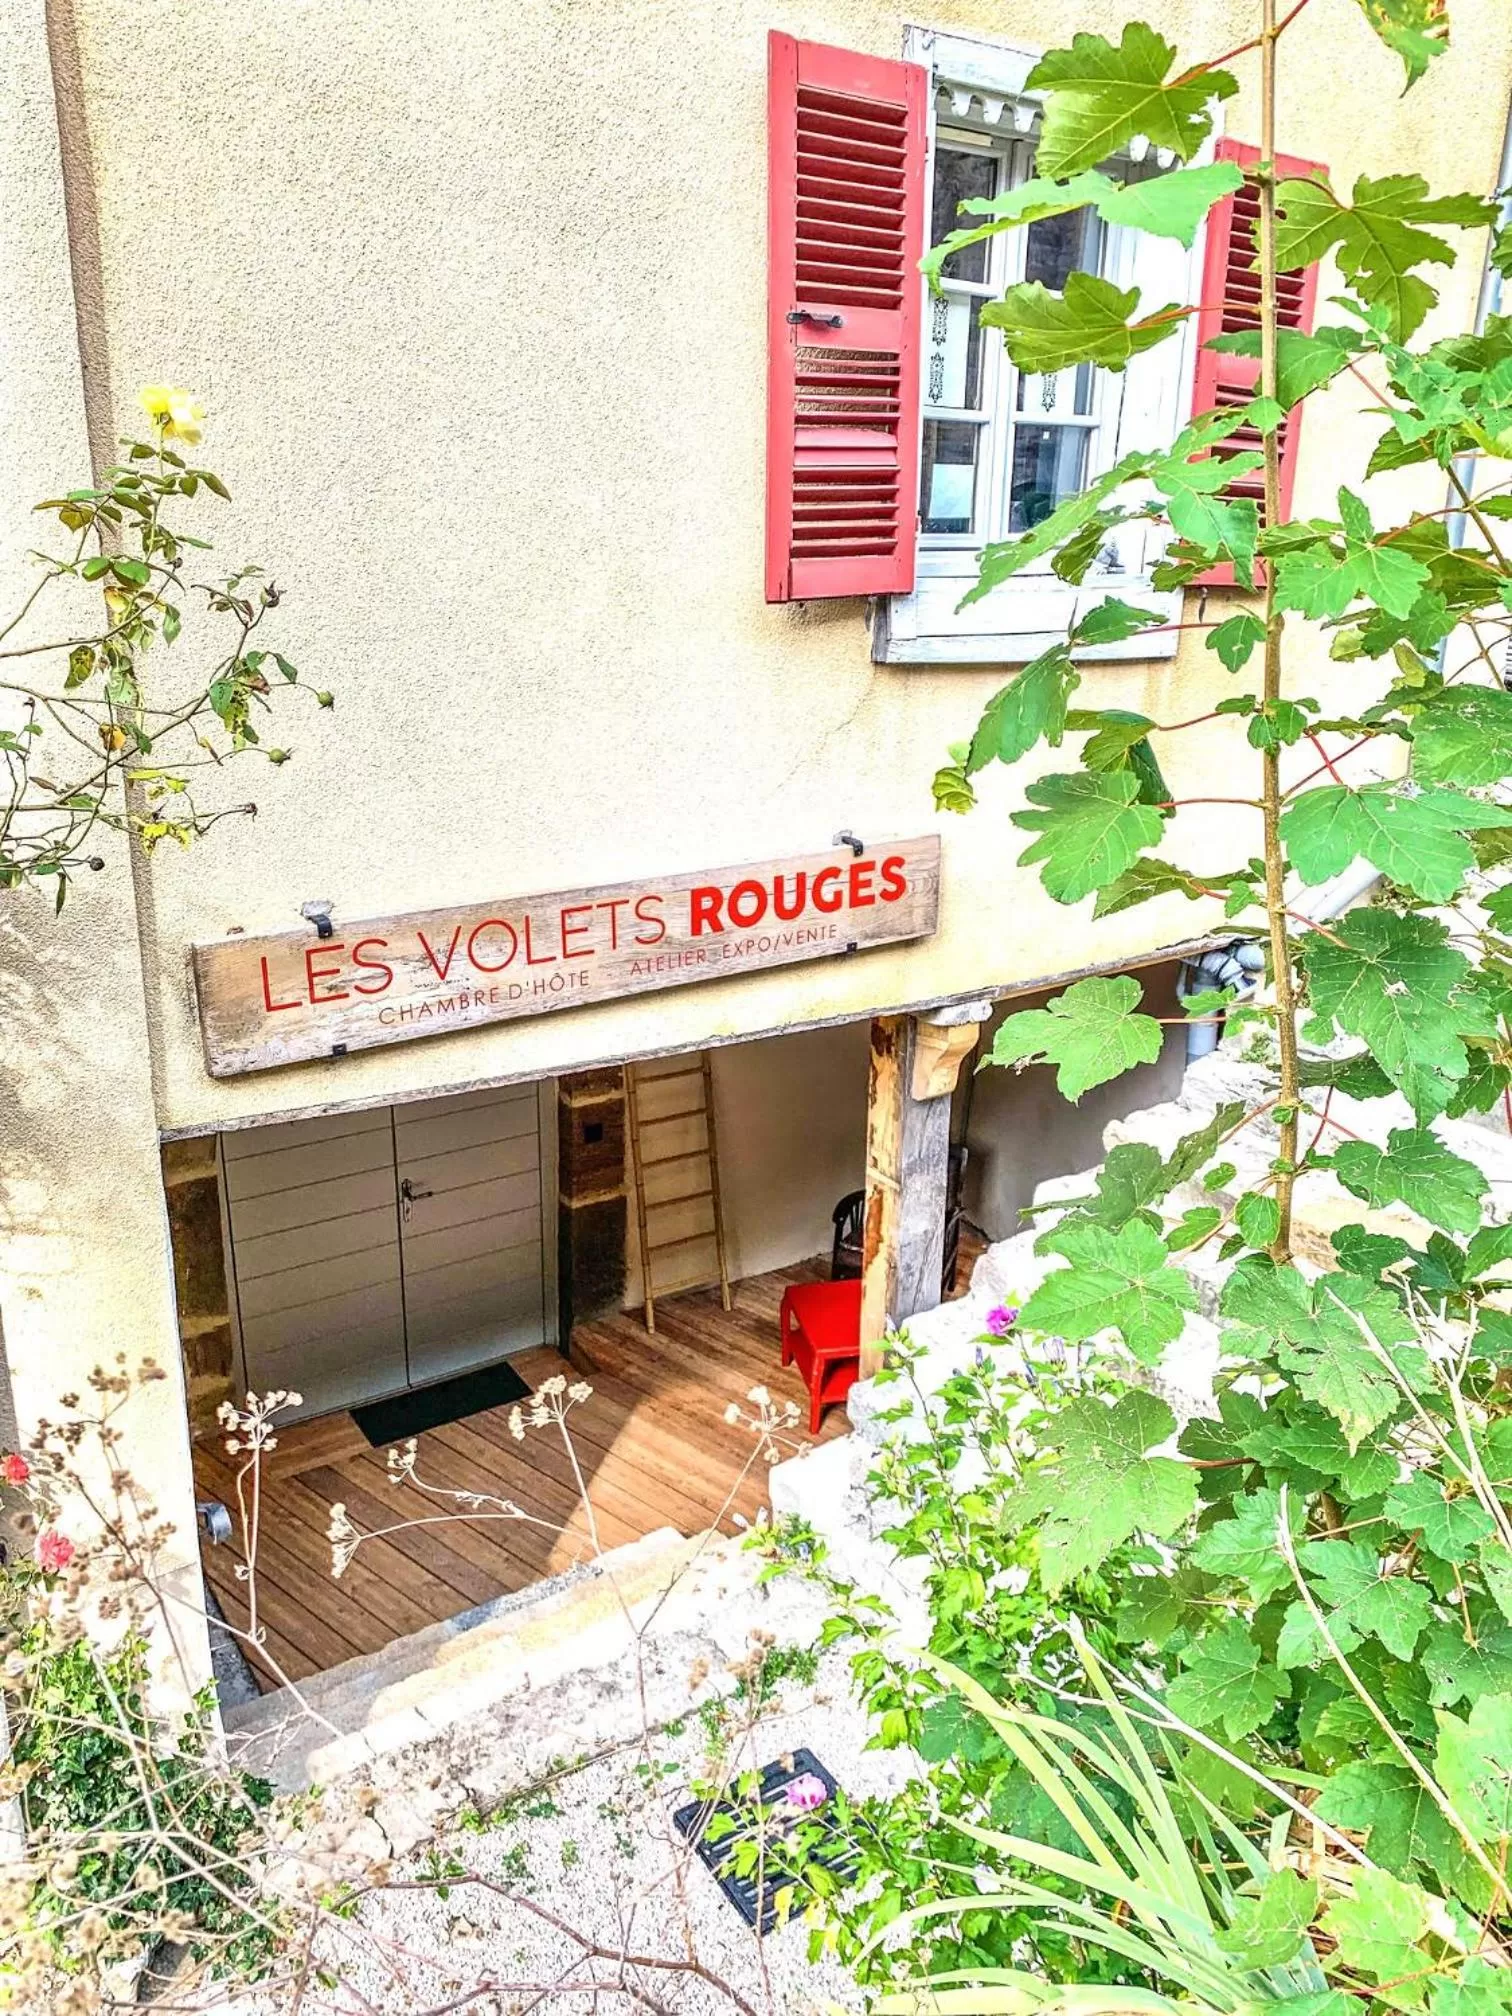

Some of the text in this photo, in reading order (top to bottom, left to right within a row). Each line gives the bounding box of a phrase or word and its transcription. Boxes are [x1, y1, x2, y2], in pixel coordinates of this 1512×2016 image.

[261, 856, 907, 1012] LES VOLETS ROUGES
[379, 924, 837, 1025] CHAMBRE D'HÔTE ATELIER EXPO/VENTE
